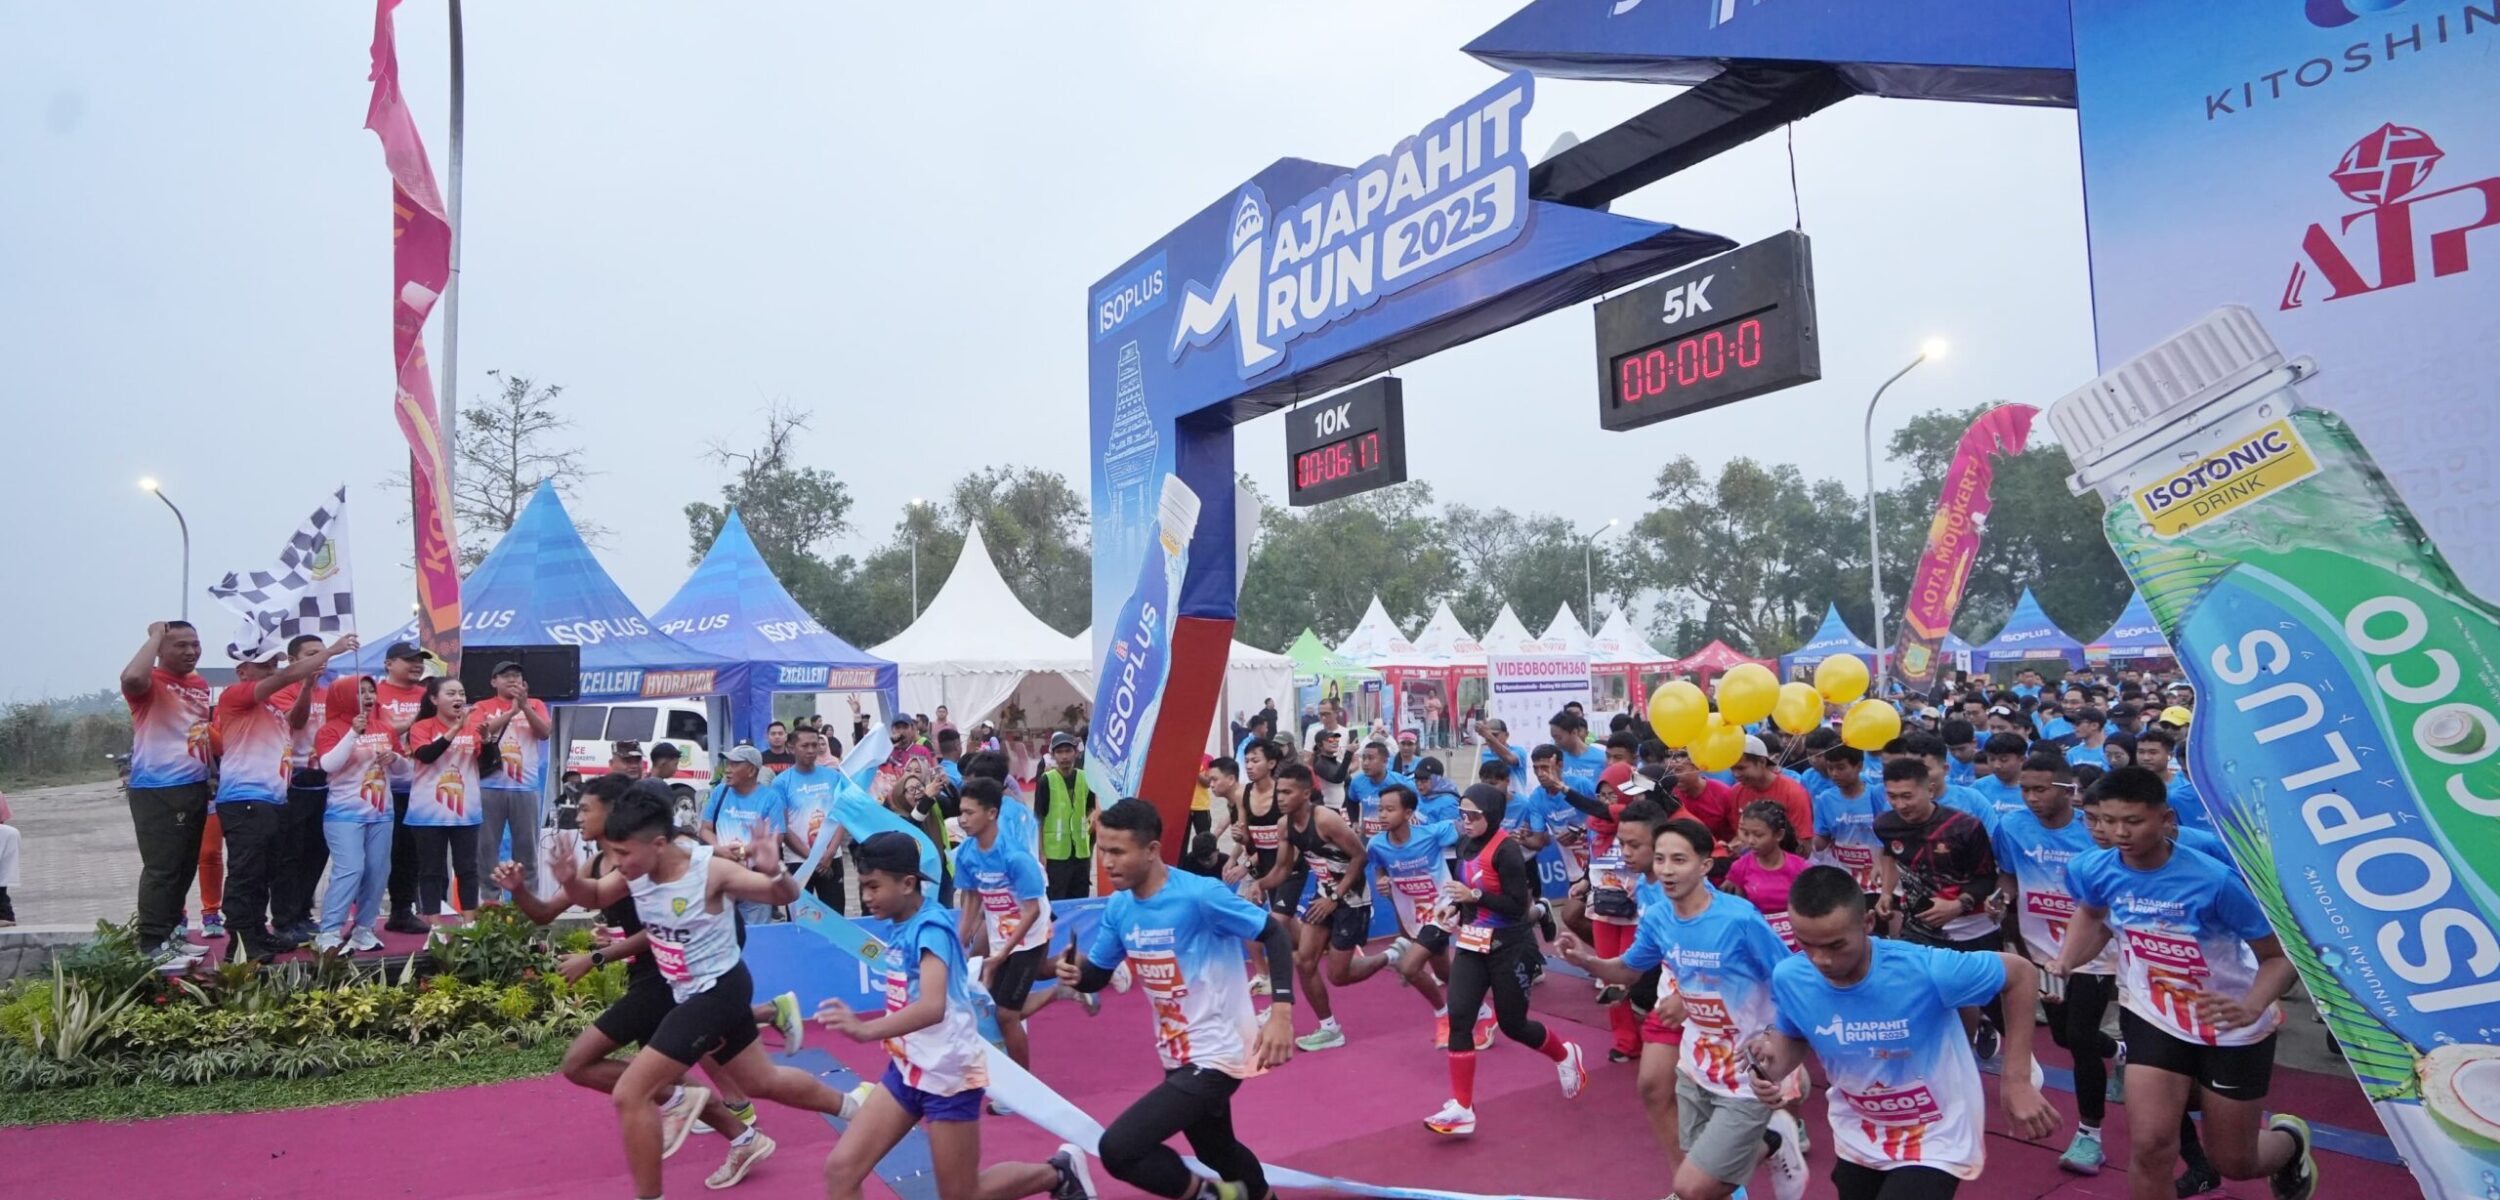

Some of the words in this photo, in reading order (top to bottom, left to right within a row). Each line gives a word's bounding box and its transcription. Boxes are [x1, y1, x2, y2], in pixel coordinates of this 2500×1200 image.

[1266, 236, 1374, 337] RUN
[1399, 182, 1496, 268] 2025
[1100, 269, 1163, 334] ISOPLUS
[1662, 275, 1715, 325] 5K
[1623, 320, 1761, 402] 00:00:0
[1314, 402, 1351, 438] 10K
[2143, 430, 2289, 513] ISOTONIC
[2193, 475, 2266, 518] DRINK
[546, 616, 648, 645] ISOPLUS
[758, 618, 826, 643] ISOPLUS
[1807, 637, 1849, 651] ISOPLUS
[2001, 629, 2051, 642] ISOPLUS
[2115, 626, 2161, 638] ISOPLU
[579, 670, 641, 696] CELLENT
[644, 669, 715, 694] HYDRATION
[779, 666, 828, 684] EXCELLENT
[830, 668, 877, 688] HYDRATION
[1105, 602, 1157, 757] ISOPLUS
[1496, 661, 1587, 676] VIDEOBOOTH360
[2210, 629, 2500, 1014] ISOPLUS
[1537, 861, 1567, 884] US
[2029, 896, 2077, 911] A065
[2304, 868, 2353, 940] ISOTONIK
[2131, 934, 2201, 960] A0560
[2347, 945, 2400, 1018] MINUMAN
[1845, 1019, 1909, 1032] AJAPAHIT
[1845, 1030, 1877, 1042] RUN
